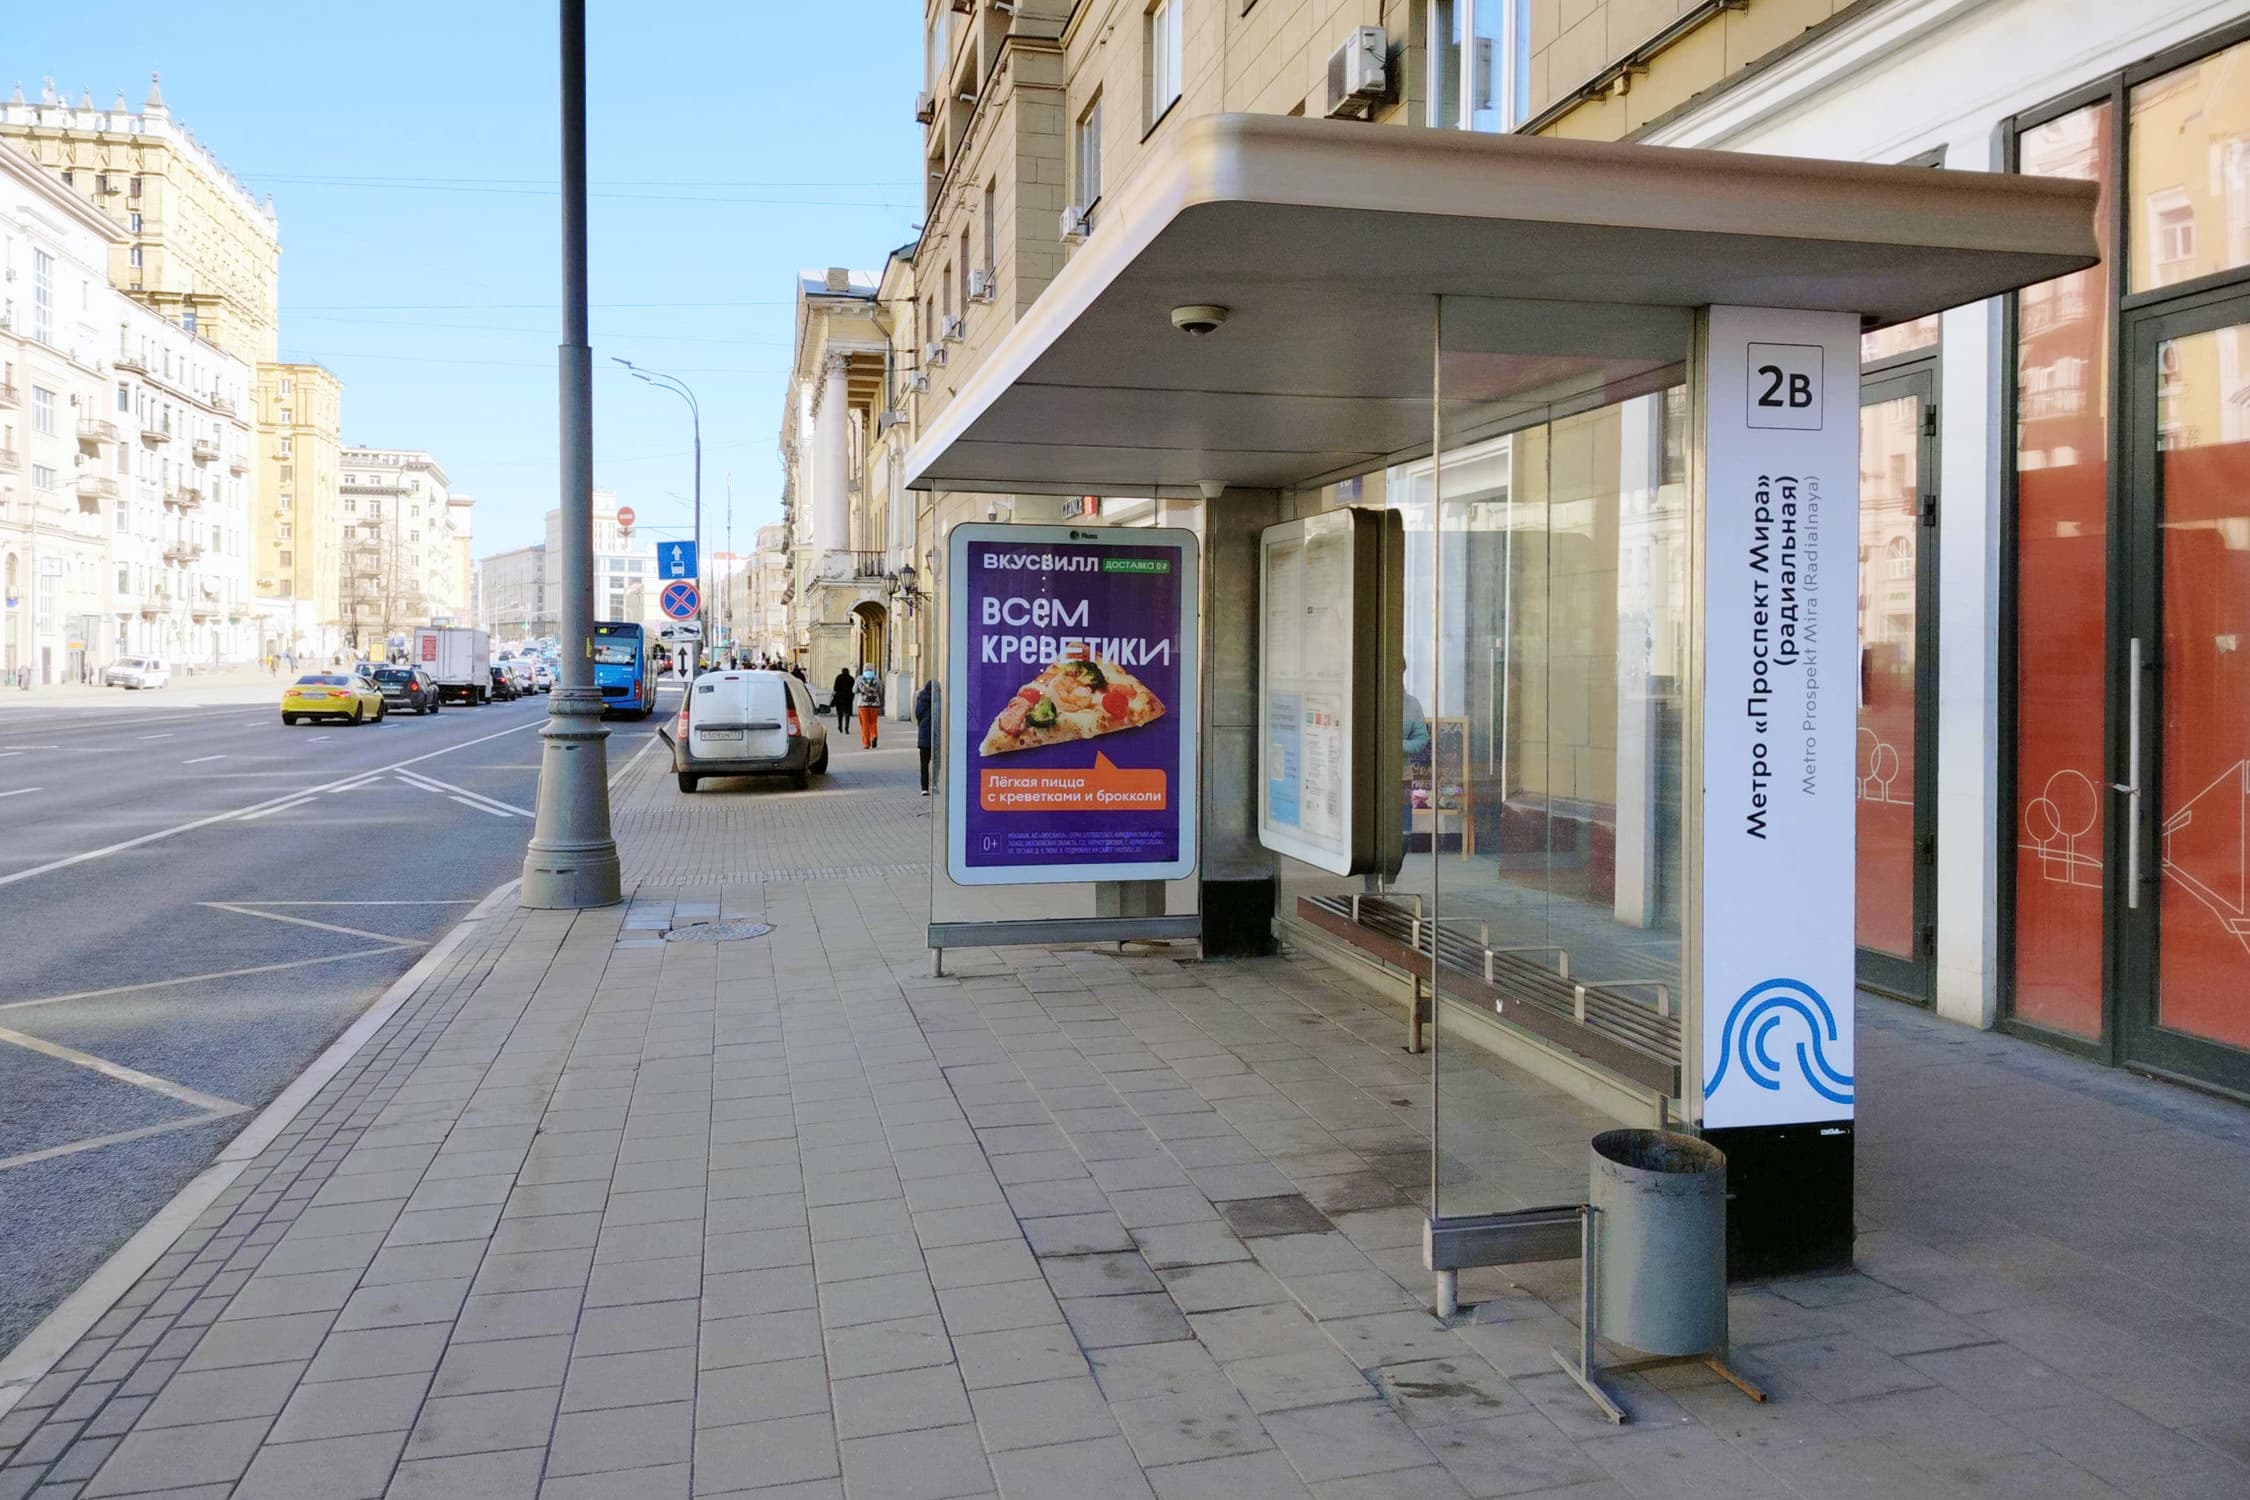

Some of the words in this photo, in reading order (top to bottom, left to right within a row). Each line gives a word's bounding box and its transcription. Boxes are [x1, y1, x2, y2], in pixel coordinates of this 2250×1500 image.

[1749, 474, 1774, 573] Мира»
[1803, 475, 1822, 592] (Radialnaya)
[983, 553, 1099, 573] ВКУСВИЛЛ
[1773, 475, 1800, 666] (радиальная)
[1802, 597, 1817, 643] Mira
[1747, 579, 1773, 734] «Проспект
[1802, 647, 1820, 732] Prospekt
[987, 793, 996, 802] с
[999, 792, 1081, 804] креветками
[1084, 792, 1093, 802] и
[1097, 789, 1162, 804] брокколи
[988, 775, 1038, 788] Лёгкая
[1041, 777, 1085, 789] пицца
[1746, 743, 1772, 839] Метро
[1802, 736, 1816, 796] Metro
[983, 836, 998, 851] 0+
